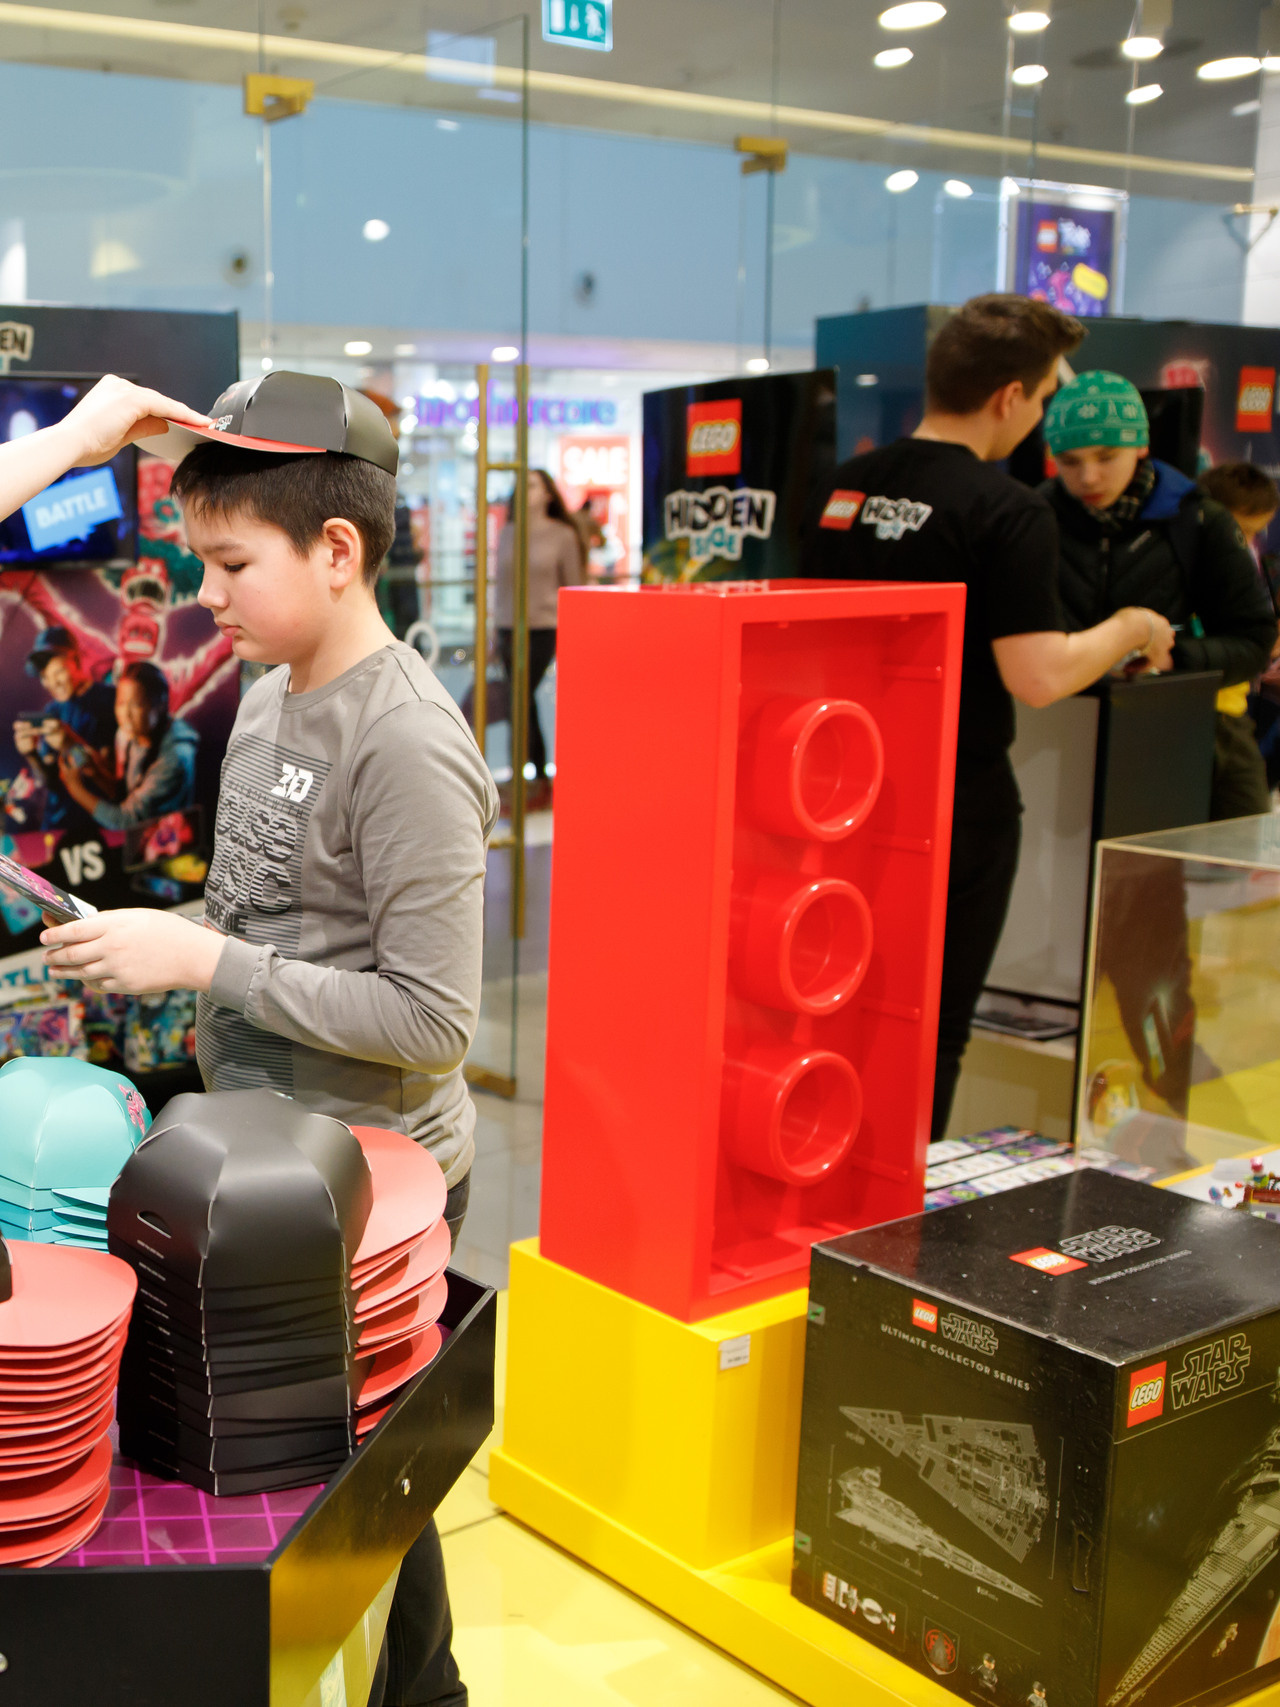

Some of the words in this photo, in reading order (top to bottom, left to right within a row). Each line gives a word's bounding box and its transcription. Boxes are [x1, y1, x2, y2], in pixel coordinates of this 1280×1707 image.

[689, 421, 738, 454] LEGO
[35, 486, 107, 529] BATTLE
[668, 490, 772, 534] HIDDEN
[825, 502, 859, 518] LEGO
[865, 498, 929, 528] HIDDEN
[693, 527, 738, 556] SIDE
[60, 840, 106, 886] VS
[913, 1307, 936, 1325] LEGO
[940, 1312, 999, 1342] STAR
[941, 1323, 999, 1356] WARS
[880, 1323, 928, 1350] ULTIMATE
[930, 1343, 991, 1376] COLLECTOR
[993, 1369, 1031, 1392] SERIES
[1130, 1378, 1163, 1410] LEGO
[1171, 1332, 1252, 1383] STAR
[1171, 1356, 1251, 1410] WARS
